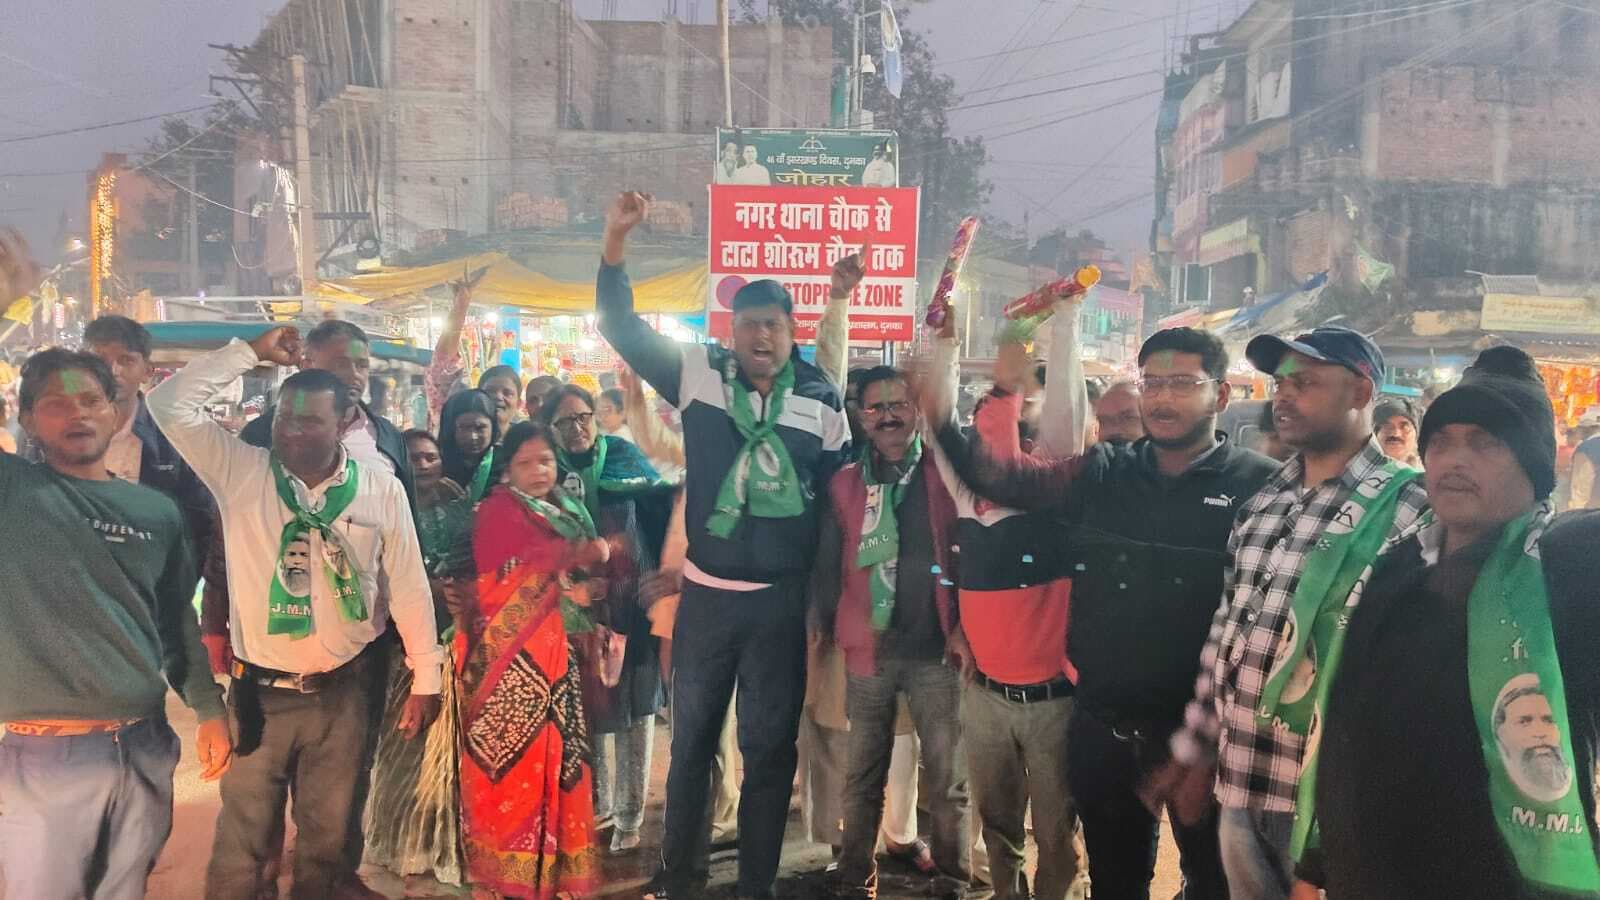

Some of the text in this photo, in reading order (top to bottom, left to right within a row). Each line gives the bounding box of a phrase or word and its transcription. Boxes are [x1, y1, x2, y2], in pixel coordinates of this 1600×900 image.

[775, 169, 853, 186] जोहार
[735, 196, 894, 232] नगर थाना चौक से
[720, 240, 760, 268] टाटा
[871, 244, 906, 271] तक
[784, 282, 903, 307] TOPPE ZONE
